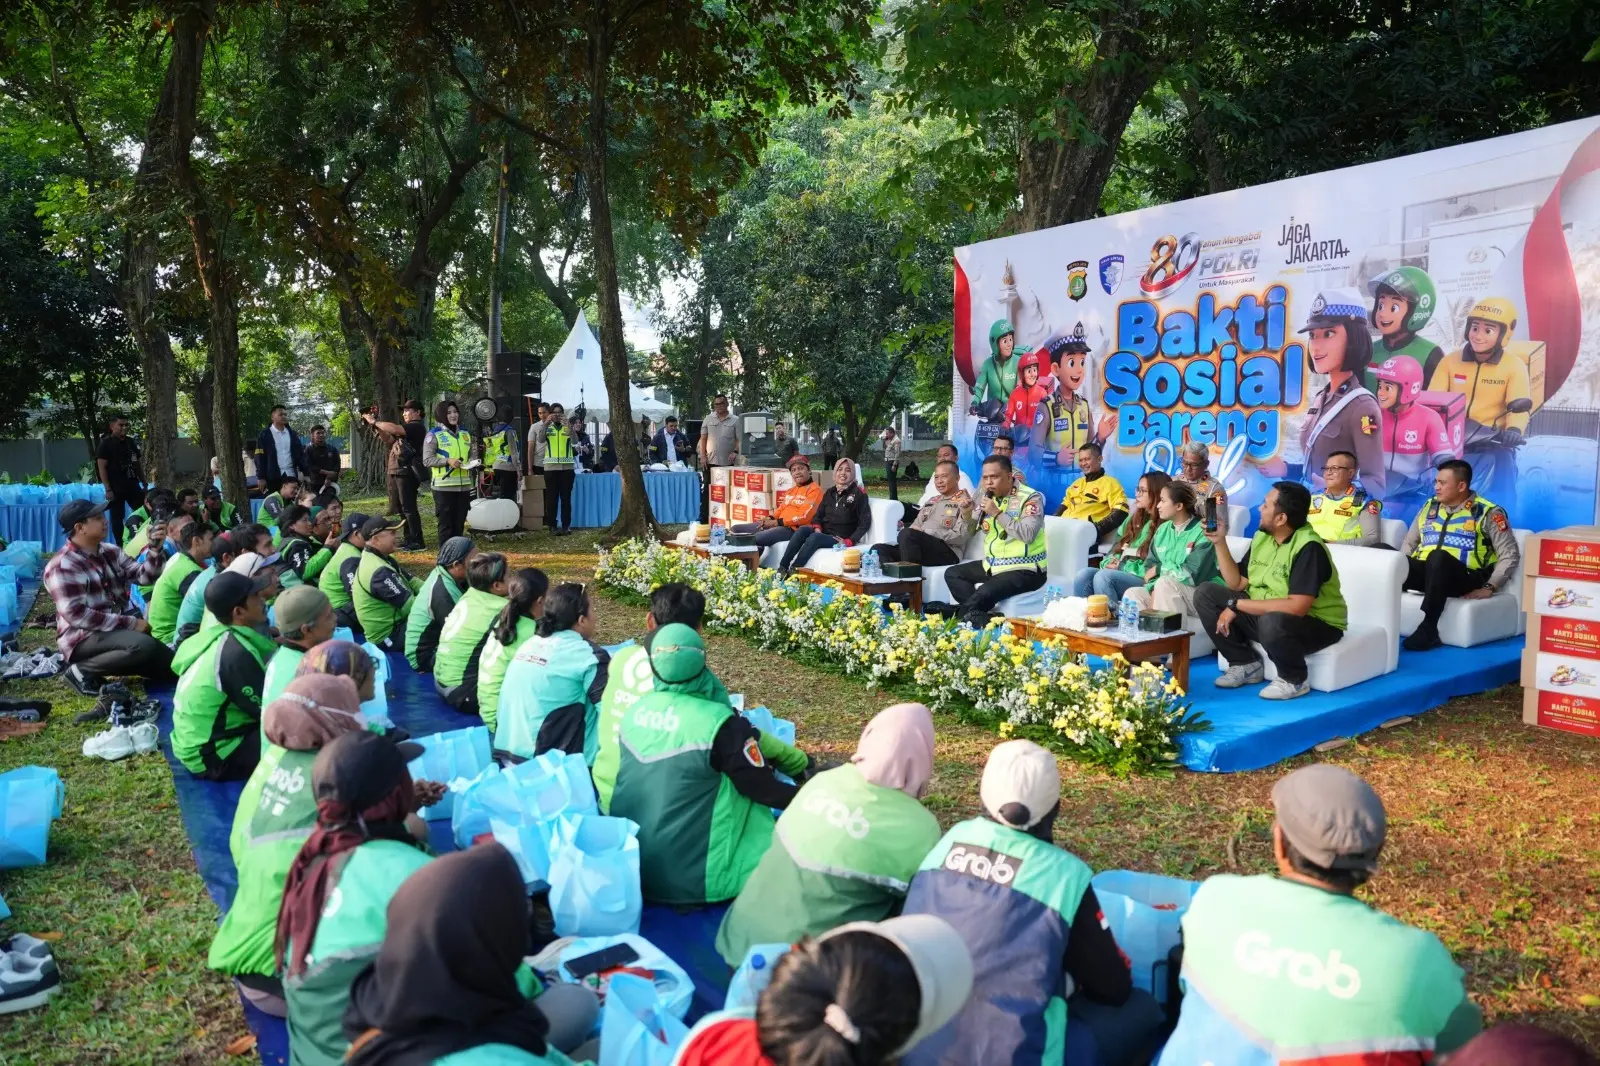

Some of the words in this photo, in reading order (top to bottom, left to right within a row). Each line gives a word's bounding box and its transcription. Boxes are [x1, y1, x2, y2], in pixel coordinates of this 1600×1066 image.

[1222, 231, 1262, 245] Mengabdi
[1278, 223, 1311, 246] JAGA
[1198, 248, 1261, 276] POLRI
[1198, 280, 1217, 289] Untuk
[1218, 276, 1256, 287] Masyarakat
[1413, 310, 1431, 321] gojek
[1474, 304, 1503, 316] maxim
[1117, 285, 1288, 359] Bakti
[1103, 342, 1304, 409] Sosial
[1117, 403, 1281, 459] Bareng
[1398, 442, 1422, 450] foodpanda
[1554, 552, 1574, 561] BAKTI
[1575, 554, 1600, 563] SOSIAL
[1553, 628, 1573, 638] BAKTI
[1574, 632, 1598, 641] SOSIAL
[633, 705, 680, 732] Grab
[1551, 703, 1571, 713] BAKTI
[1572, 707, 1597, 718] SOSIAL
[801, 787, 870, 840] Grab
[944, 844, 1015, 884] Grab
[1233, 930, 1362, 999] Grab
